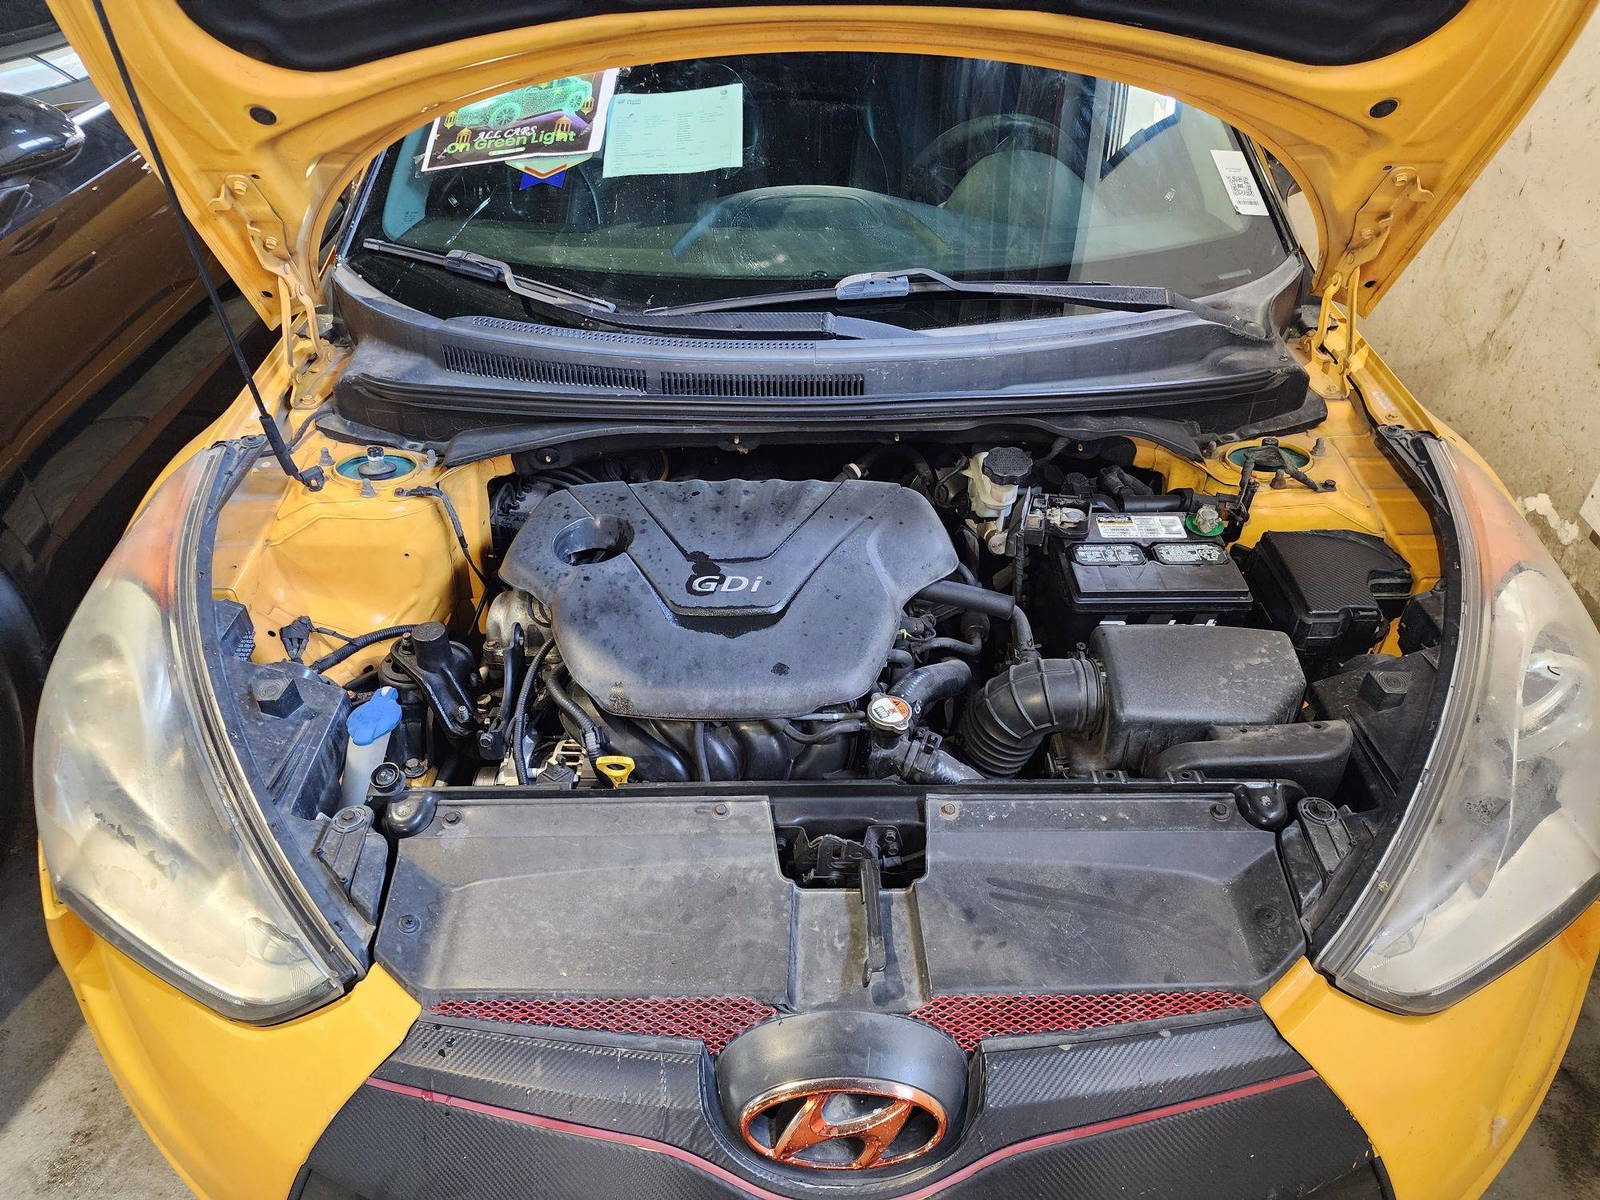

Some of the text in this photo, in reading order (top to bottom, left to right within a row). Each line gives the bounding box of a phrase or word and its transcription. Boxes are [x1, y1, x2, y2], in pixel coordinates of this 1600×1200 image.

[473, 125, 538, 142] ALL CARS
[474, 134, 528, 150] Green
[531, 130, 576, 145] Light
[692, 575, 763, 593] GDi
